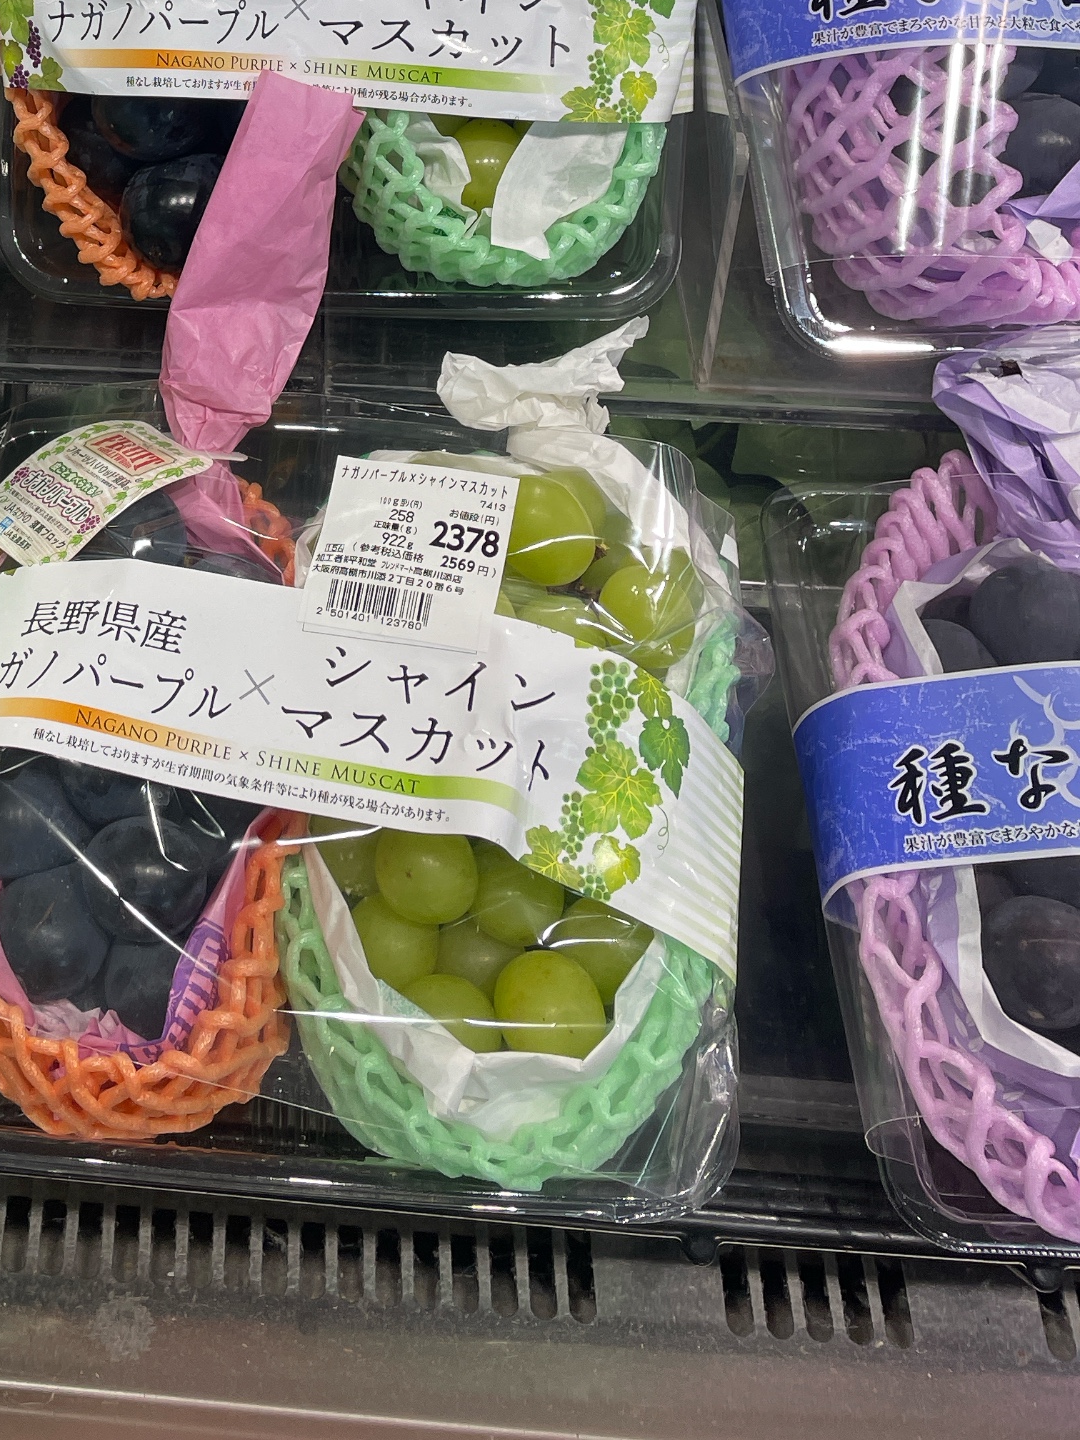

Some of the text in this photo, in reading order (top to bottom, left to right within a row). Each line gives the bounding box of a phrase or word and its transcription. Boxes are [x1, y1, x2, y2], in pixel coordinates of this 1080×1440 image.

[155, 52, 443, 84] NAGANO PURPLE SHINE MUSCAT
[319, 19, 571, 68] マスカット
[92, 434, 166, 472] FRUIT
[20, 468, 95, 525] ナガノパープル
[480, 500, 506, 512] 7413
[381, 532, 414, 550] 922g
[389, 509, 500, 558] 258 2378
[21, 600, 187, 654] 長野県産
[330, 609, 422, 631] 501401 123780
[325, 646, 556, 712] シャイン
[75, 708, 420, 794] NAGANO PURPLE SHINE MUSCAT
[282, 705, 550, 793] マスカット
[904, 821, 1080, 852] 果汁が豊富でまろやかな
